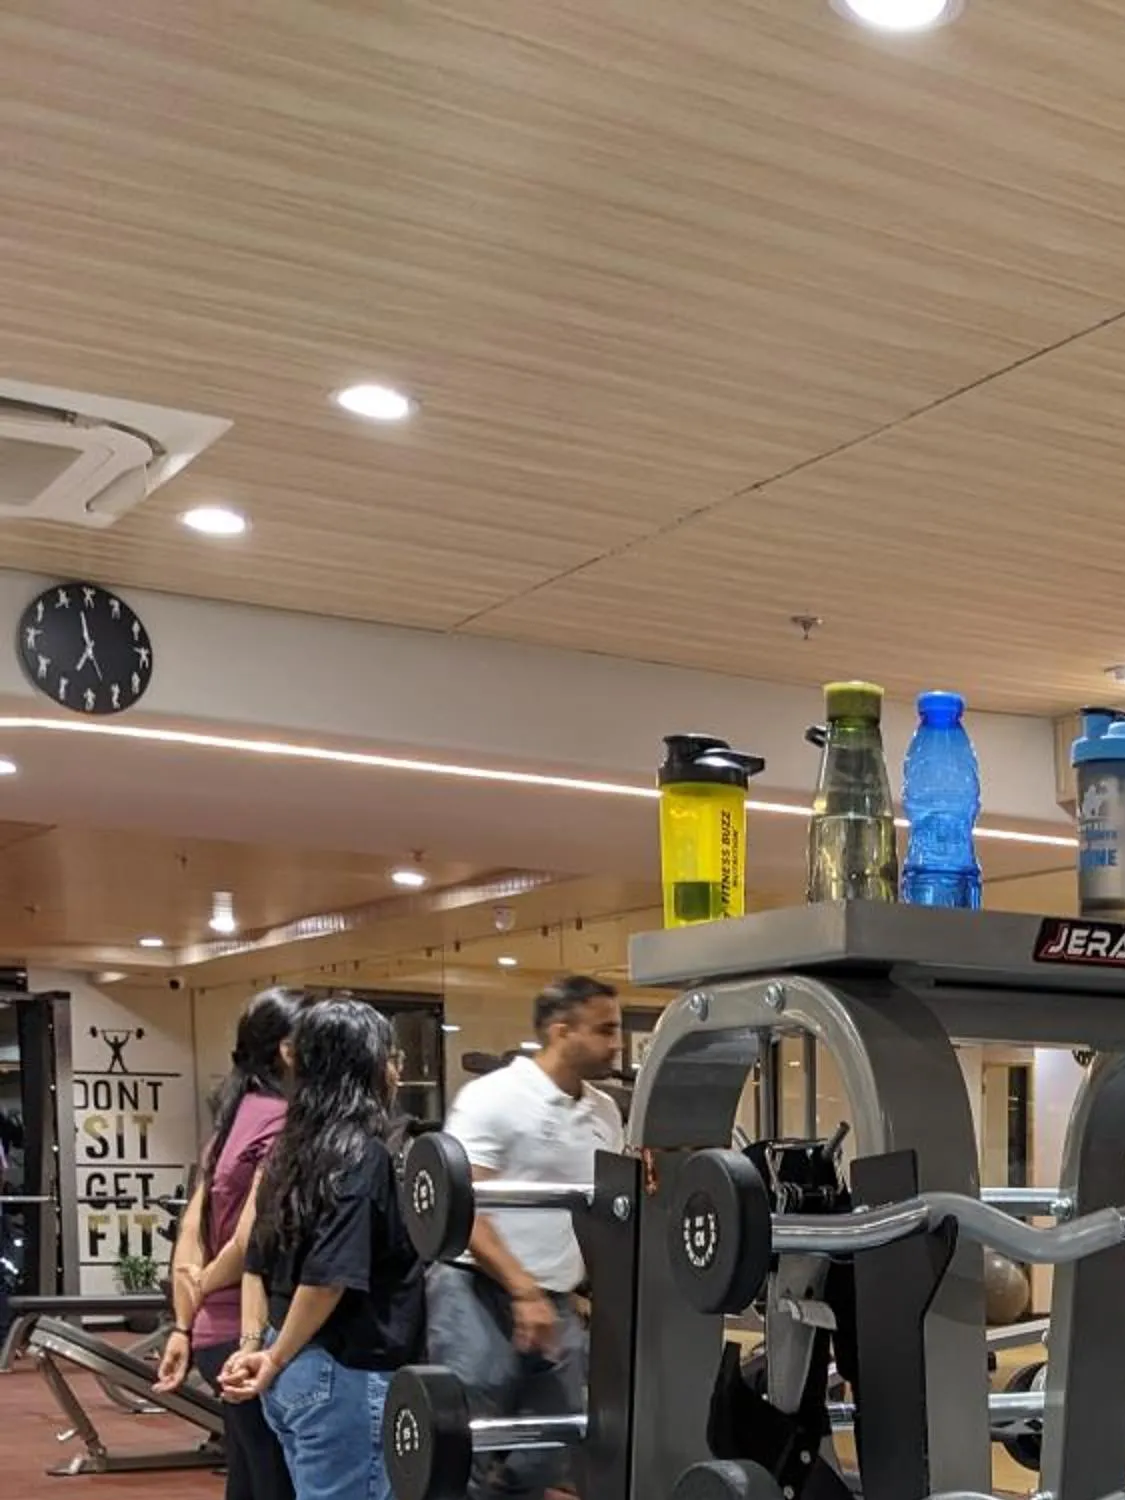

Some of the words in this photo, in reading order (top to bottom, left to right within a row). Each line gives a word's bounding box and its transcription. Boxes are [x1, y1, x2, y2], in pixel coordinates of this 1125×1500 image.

[721, 809, 731, 846] BUZZ
[721, 848, 731, 905] FITNESS
[73, 1079, 163, 1112] DON'T
[83, 1114, 154, 1159] SIT
[86, 1172, 154, 1210] GET
[88, 1214, 161, 1257] FIT
